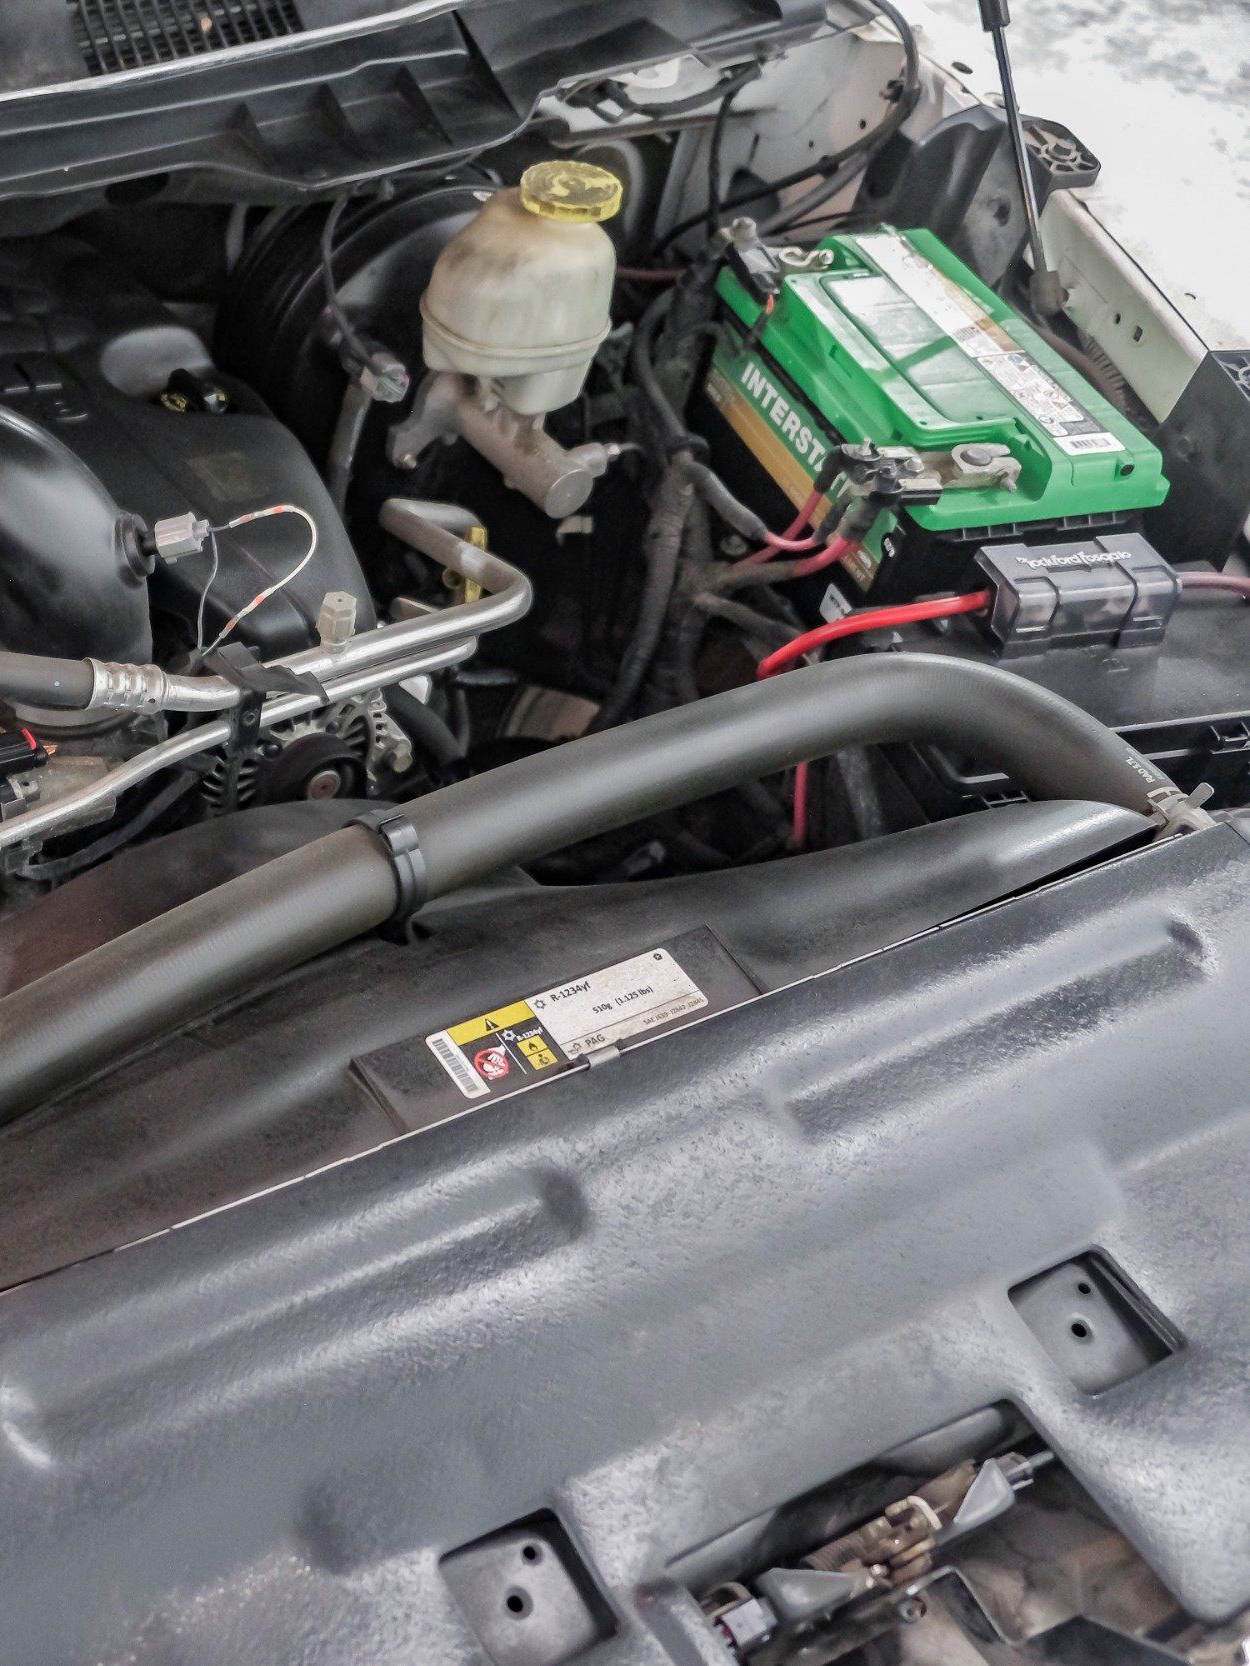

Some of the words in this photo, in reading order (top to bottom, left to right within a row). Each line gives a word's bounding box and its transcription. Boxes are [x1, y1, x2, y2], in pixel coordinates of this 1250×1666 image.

[1138, 768, 1156, 783] RAD
[550, 981, 591, 1002] R-1234yf
[592, 1002, 613, 1014] 510g
[615, 990, 639, 1006] (1.125
[639, 985, 654, 996] lbs)
[585, 1034, 606, 1048] PAG
